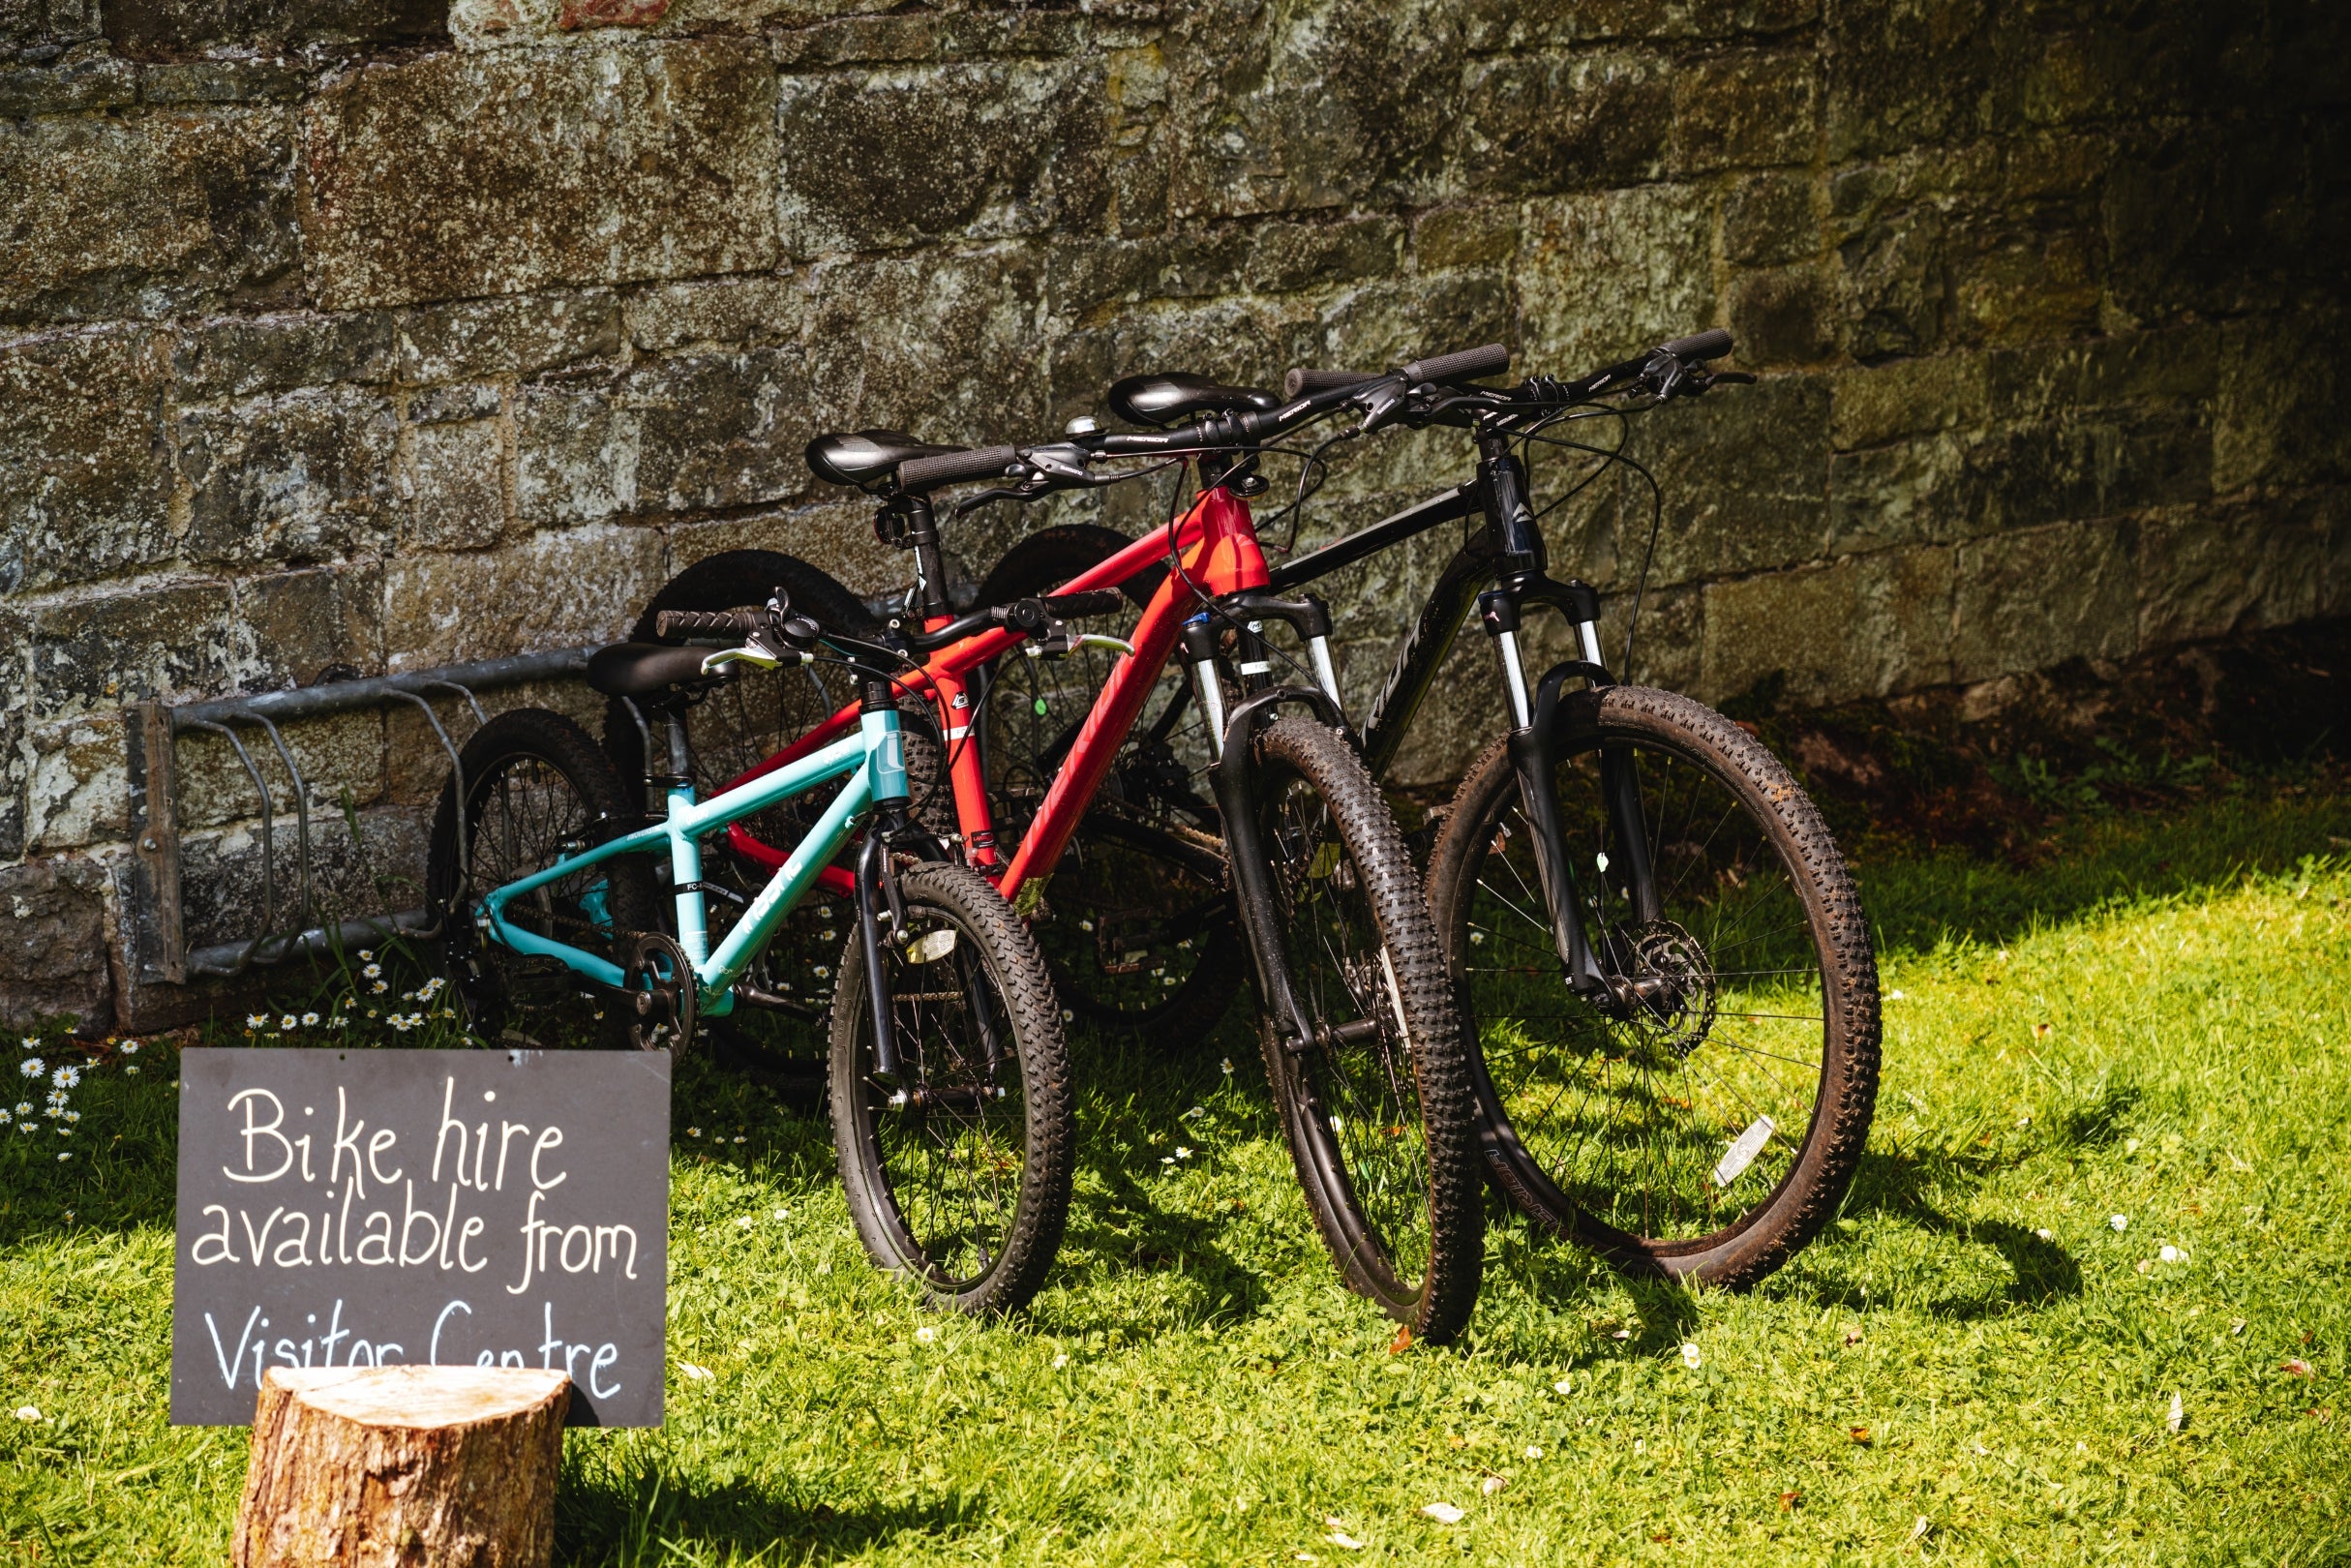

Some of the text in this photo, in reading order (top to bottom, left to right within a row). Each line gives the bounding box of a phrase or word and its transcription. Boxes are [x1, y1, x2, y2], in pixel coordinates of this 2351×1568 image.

[1279, 400, 1311, 422] MERIDA
[1480, 390, 1512, 402] MERIDA
[1127, 435, 1169, 444] MERIDA
[223, 1076, 567, 1199] Bike hire
[192, 1177, 638, 1295] available from
[204, 1299, 404, 1390] Visitor
